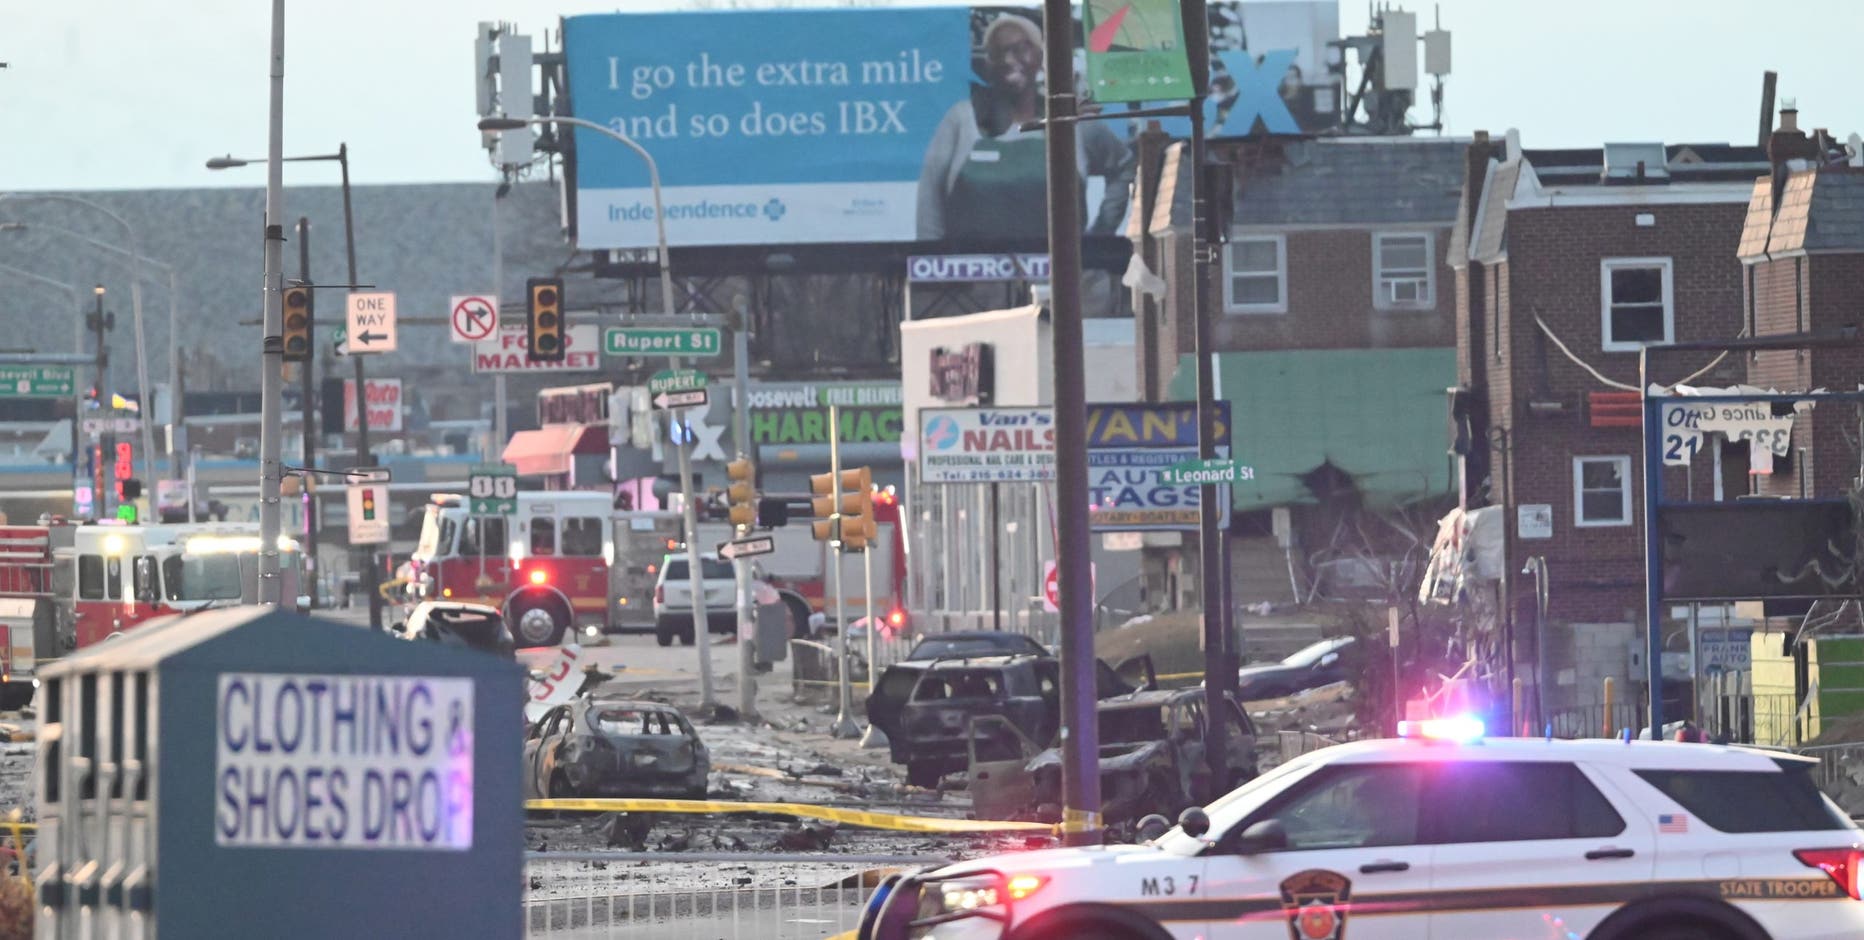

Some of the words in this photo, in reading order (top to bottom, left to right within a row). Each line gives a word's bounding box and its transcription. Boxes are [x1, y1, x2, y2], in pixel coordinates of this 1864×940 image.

[608, 57, 618, 88] I
[631, 66, 673, 98] go
[700, 55, 745, 87] the
[757, 58, 849, 87] extra
[861, 50, 943, 84] mile
[609, 105, 679, 140] and
[689, 112, 731, 138] so
[740, 102, 826, 136] does
[838, 100, 908, 134] IBX
[913, 257, 1049, 278] OUTFRONT
[356, 298, 386, 311] ONE
[356, 314, 386, 326] WAY
[502, 335, 574, 350] FOD
[614, 333, 681, 351] Rupert
[691, 333, 712, 348] St
[651, 375, 695, 391] RUPERT
[353, 409, 395, 427] one
[732, 411, 903, 442] HARMAC
[979, 411, 1051, 426] Van's
[964, 429, 1055, 452] NAILS
[927, 454, 982, 465] PROFESSIONAL
[1131, 453, 1187, 466] REGISTRA
[1101, 469, 1163, 485] AUT
[1175, 466, 1235, 483] Leonard
[1240, 466, 1254, 481] St
[1089, 486, 1200, 507] TAGS
[222, 679, 434, 755] CLOTHING
[445, 698, 467, 756] &
[219, 766, 349, 841] SHOES
[362, 768, 468, 842] DROP
[1187, 875, 1199, 895] 7
[1719, 881, 1763, 896] STATE
[1767, 881, 1837, 896] TROOPER
